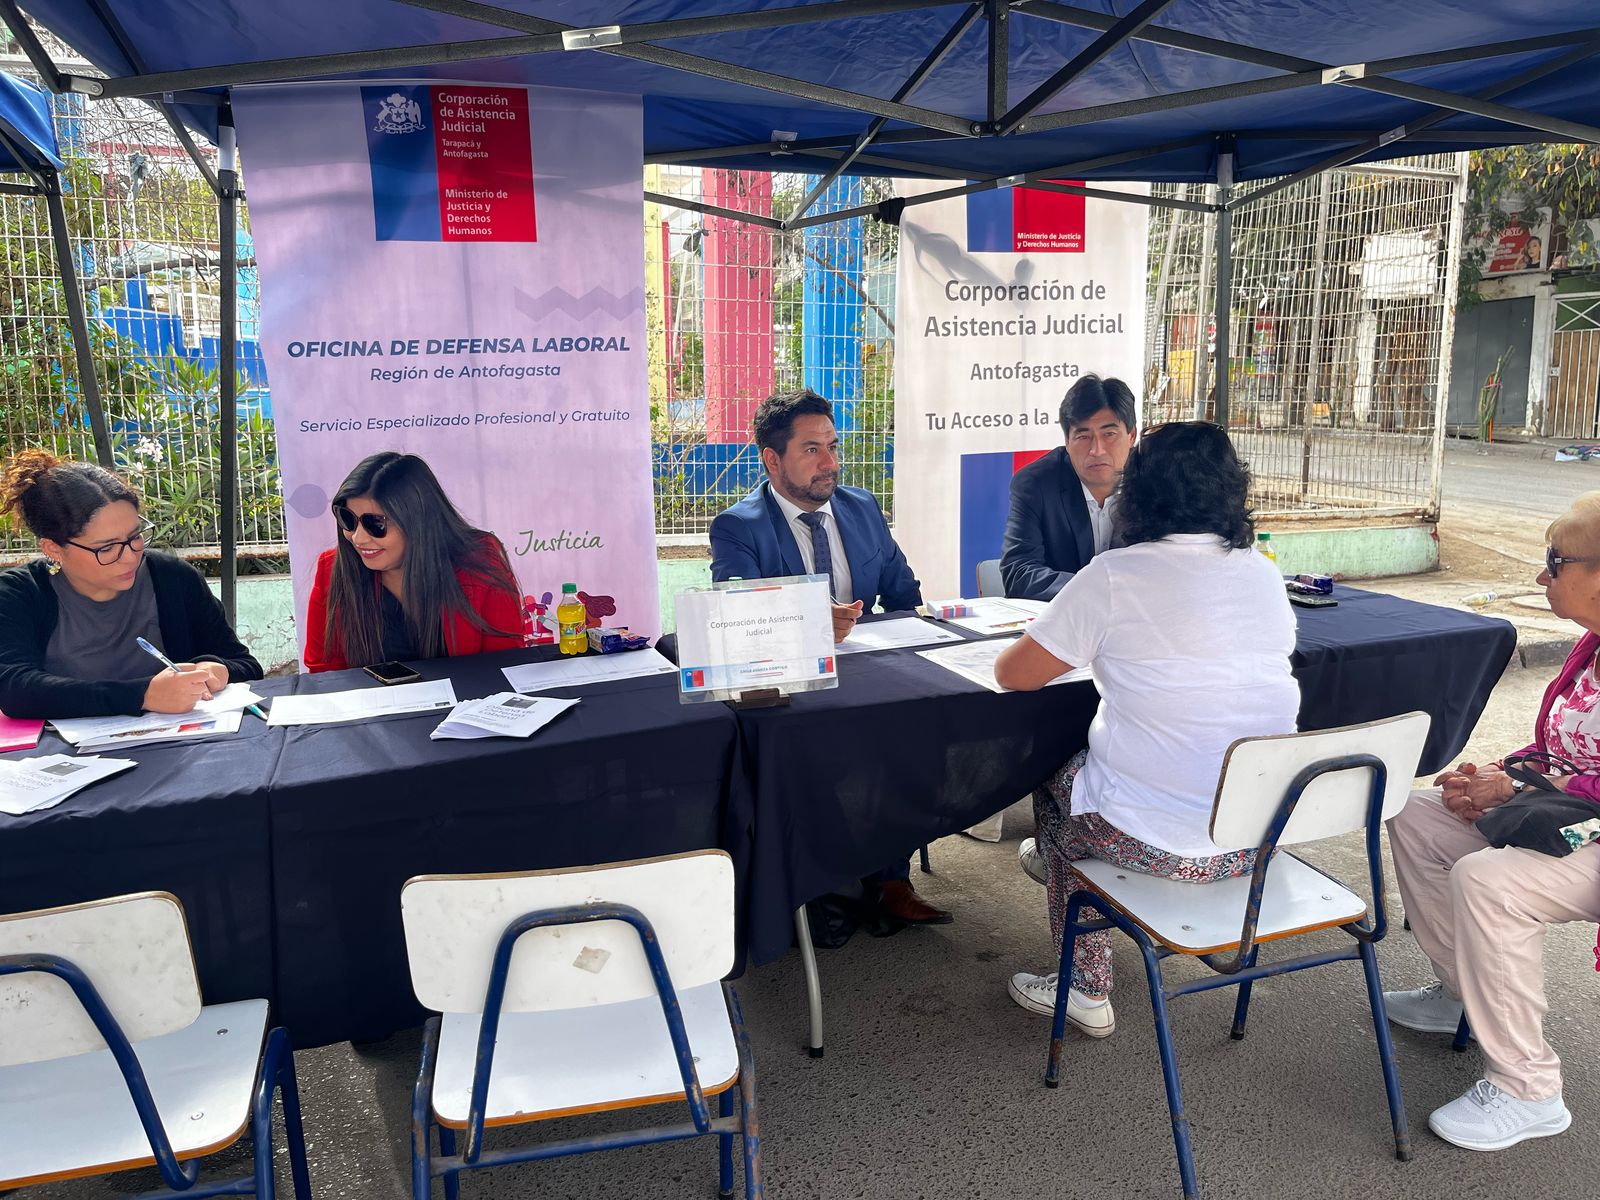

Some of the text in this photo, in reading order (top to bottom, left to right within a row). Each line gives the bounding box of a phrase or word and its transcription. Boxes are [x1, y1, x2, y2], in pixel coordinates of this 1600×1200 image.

[438, 93, 508, 106] Corporación
[440, 107, 516, 120] de Asistencia
[441, 121, 485, 132] Judicial
[442, 139, 474, 148] Tarapacá
[443, 150, 488, 159] Antofagasta
[446, 189, 508, 198] Ministerio de
[447, 202, 490, 212] Justicia y
[448, 214, 491, 222] Derechos
[448, 226, 492, 235] Humanos
[945, 279, 1106, 306] Corporación de
[924, 314, 1123, 337] Asistencia Judicial
[288, 337, 630, 357] OFICINA DE DEFENSA LABORAL
[371, 364, 561, 383] Región de Antofagasta
[970, 362, 1079, 383] Antofagasta
[300, 409, 630, 432] Servicio Especializado Profesional y Gratuito
[925, 413, 945, 430] Tu
[951, 412, 1013, 429] Acceso
[1019, 413, 1028, 426] a
[1034, 408, 1049, 425] la
[515, 530, 604, 556] Justicia
[710, 614, 804, 629] Corporación de Asistencia
[746, 628, 772, 636] Judicial
